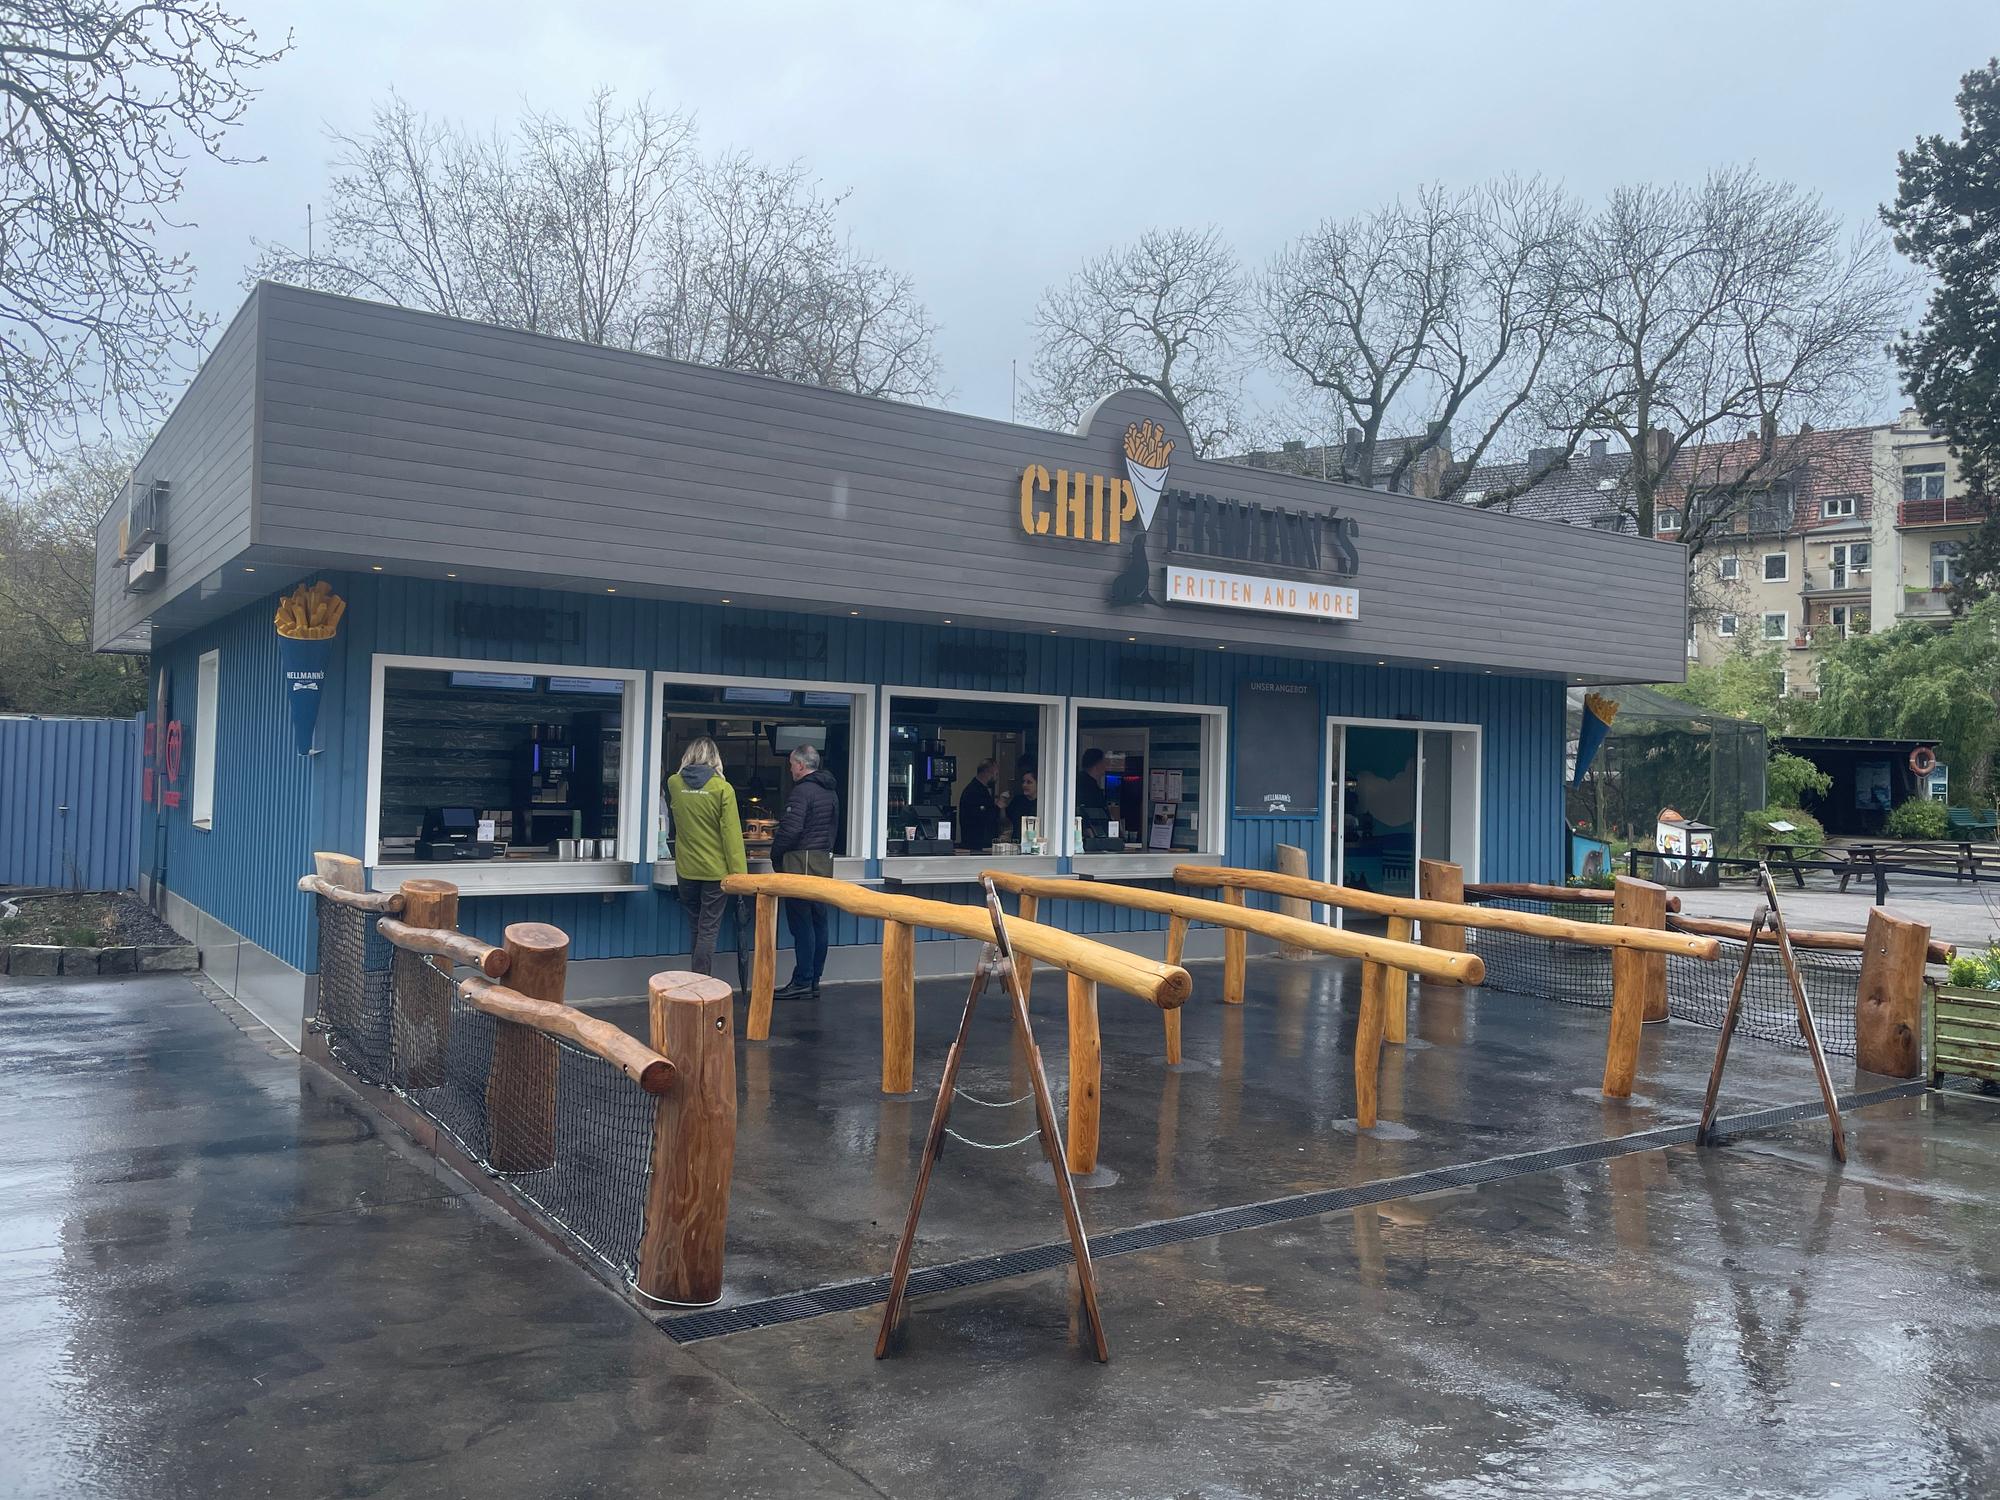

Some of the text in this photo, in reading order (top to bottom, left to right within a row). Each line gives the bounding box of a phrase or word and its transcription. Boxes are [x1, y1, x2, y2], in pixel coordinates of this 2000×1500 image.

[1021, 463, 1137, 543] CHIP
[1173, 574, 1353, 614] FRITTEN AND MORE
[286, 669, 325, 680] HELLMANN'S
[1250, 681, 1308, 695] UNSER ANGEBOT
